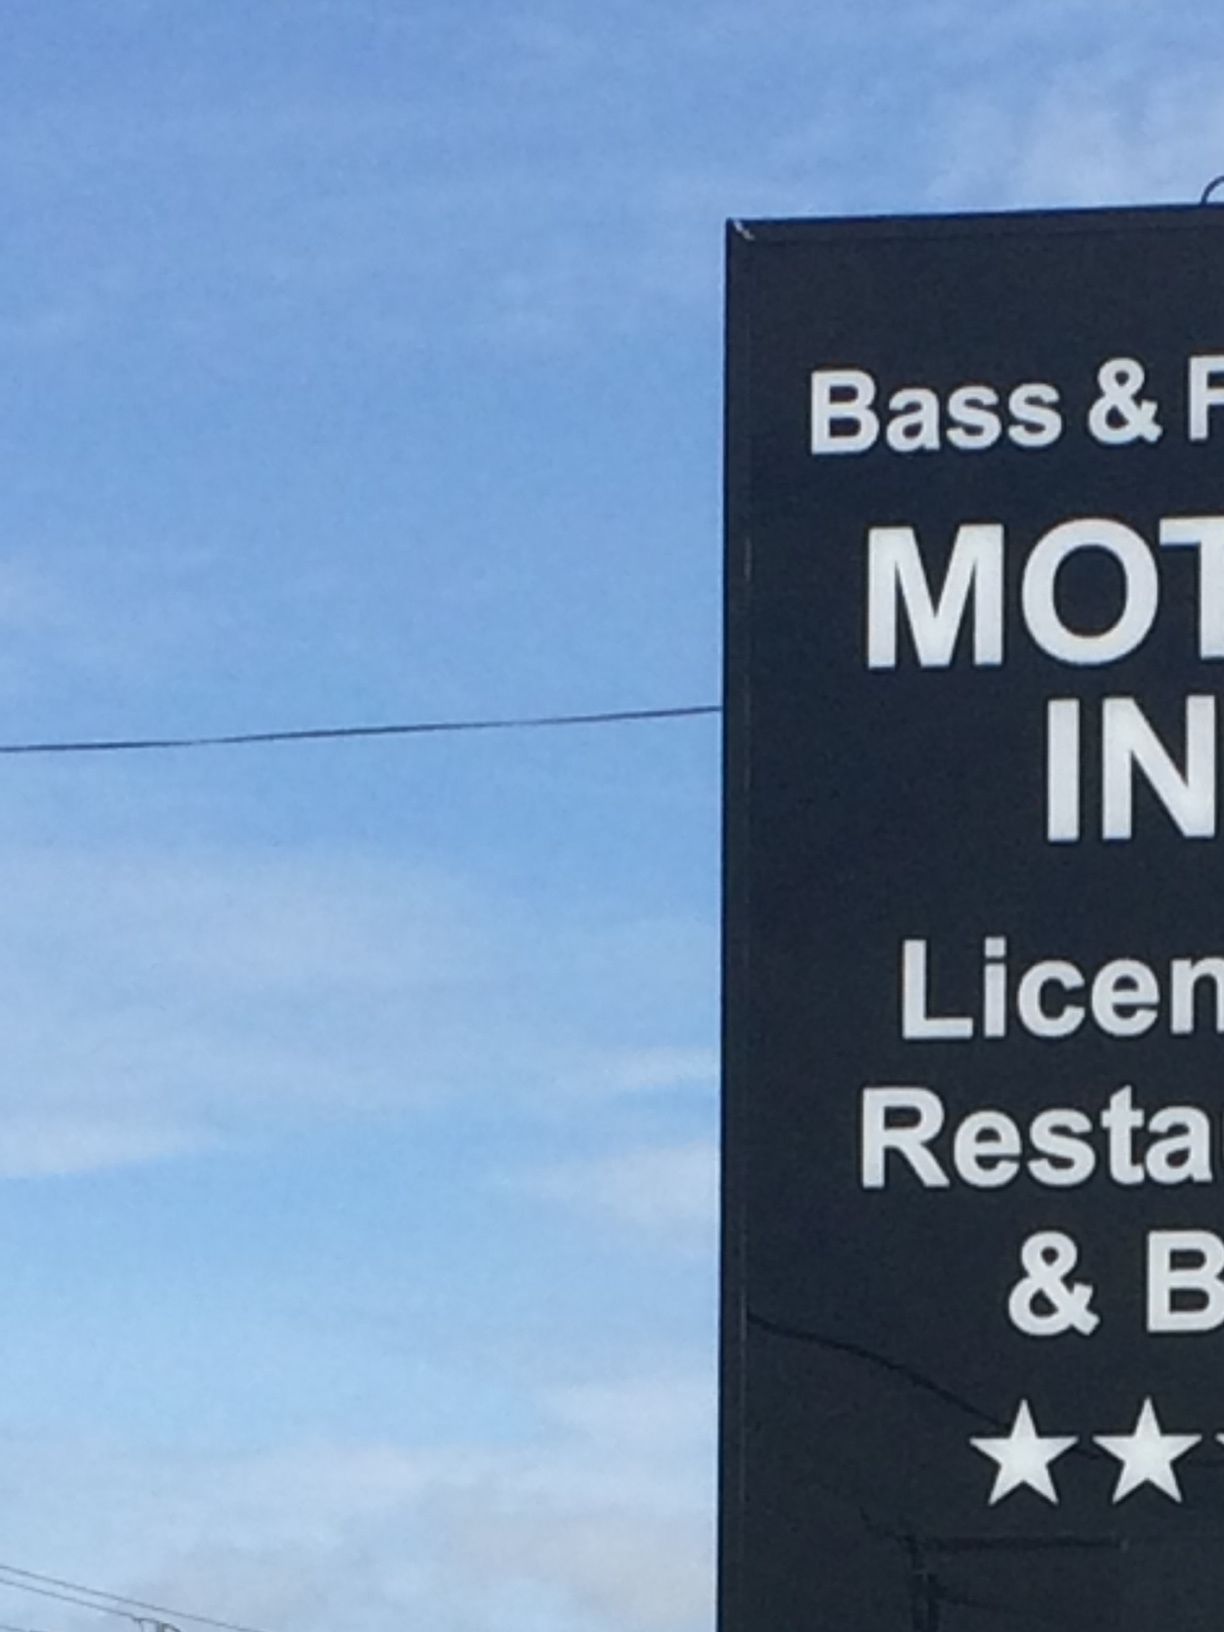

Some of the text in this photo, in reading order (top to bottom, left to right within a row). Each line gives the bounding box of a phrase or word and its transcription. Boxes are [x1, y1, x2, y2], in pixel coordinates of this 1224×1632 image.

[812, 371, 1061, 453] Bass
[1089, 359, 1161, 443] &
[1008, 1232, 1098, 1335] &
